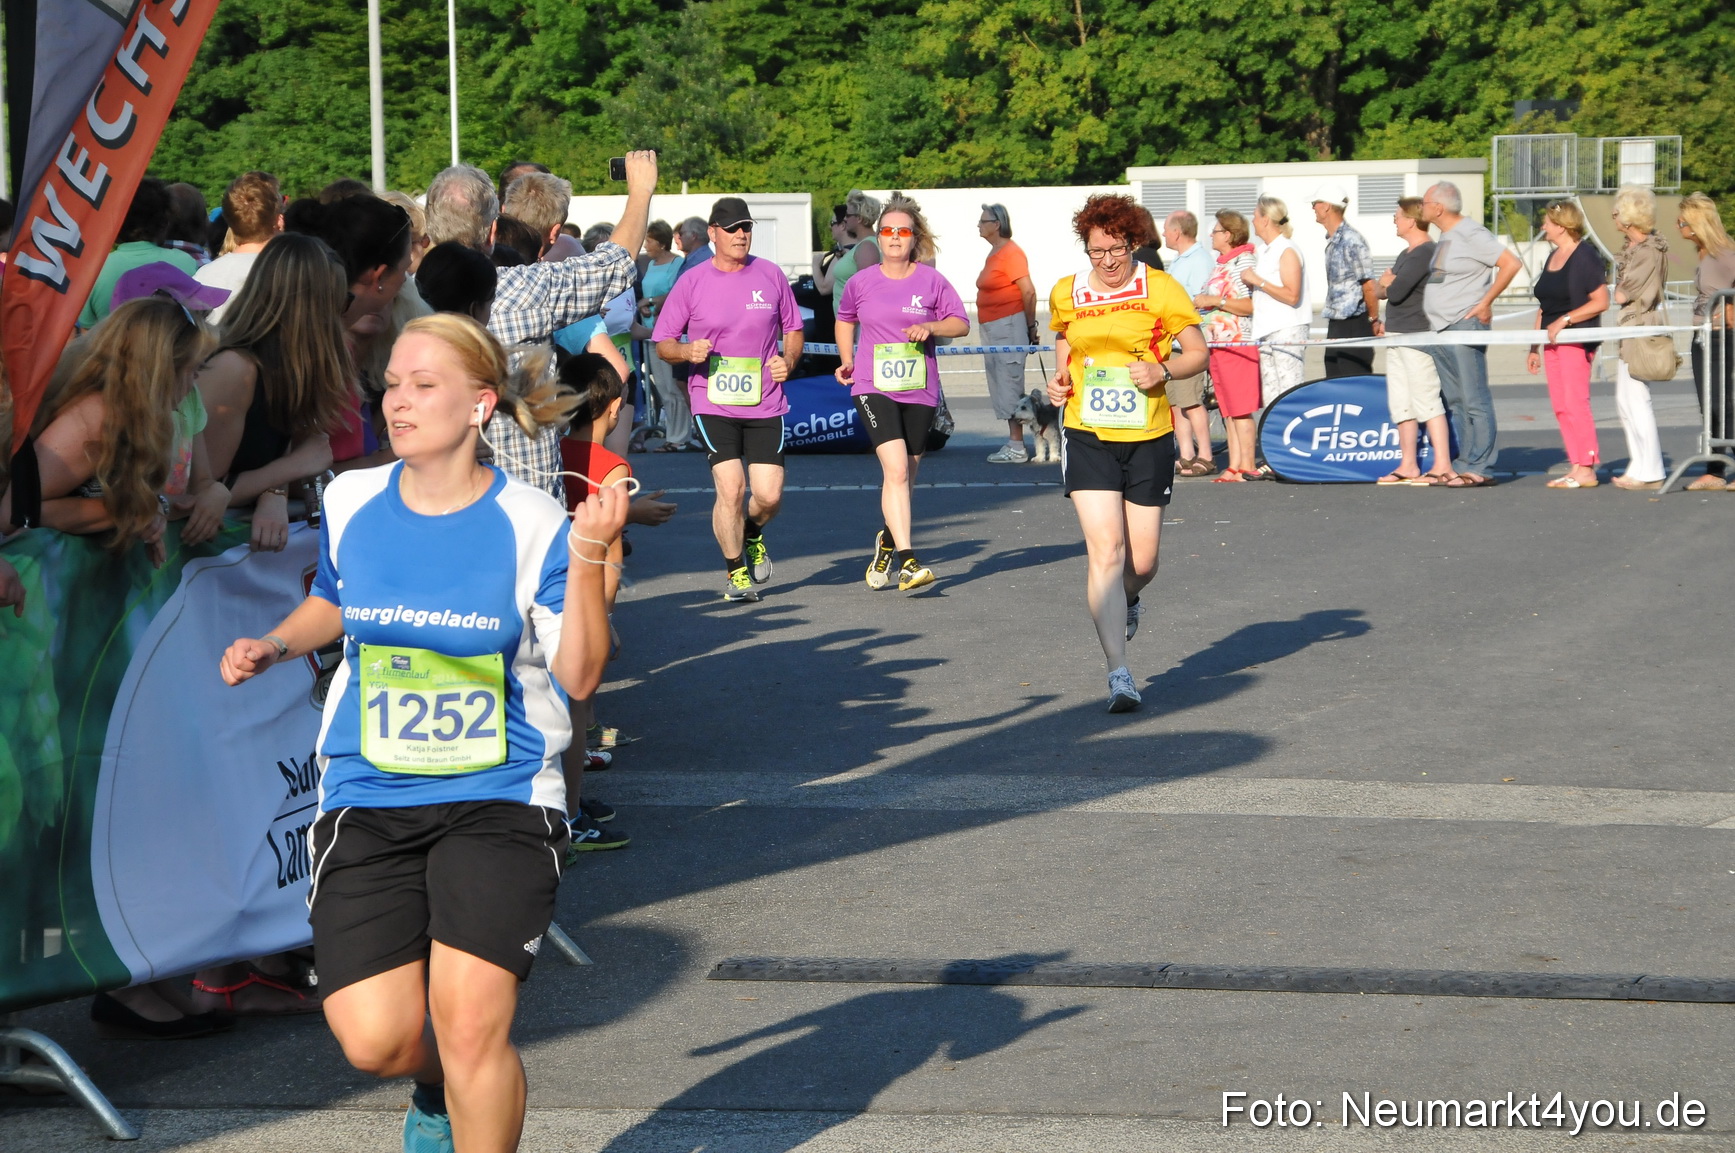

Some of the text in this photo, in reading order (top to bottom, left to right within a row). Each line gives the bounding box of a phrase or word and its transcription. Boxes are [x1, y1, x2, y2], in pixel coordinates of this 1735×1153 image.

[751, 290, 765, 303] K
[911, 294, 923, 309] K
[1075, 302, 1150, 320] MAX BÖGL
[881, 358, 917, 379] 607
[715, 373, 753, 393] 606
[1090, 387, 1137, 413] 833
[784, 407, 857, 440] scher
[863, 403, 878, 428] odlo
[784, 427, 855, 448] TOMOBILE
[1311, 421, 1429, 450] Fisch
[1322, 447, 1429, 462] AUTOMOBE
[344, 604, 500, 631] energiegeladen
[382, 666, 430, 679] firmenlauf
[366, 690, 497, 742] 1252
[393, 754, 410, 762] Seitz
[406, 744, 426, 753] Katja
[266, 821, 313, 889] Lam
